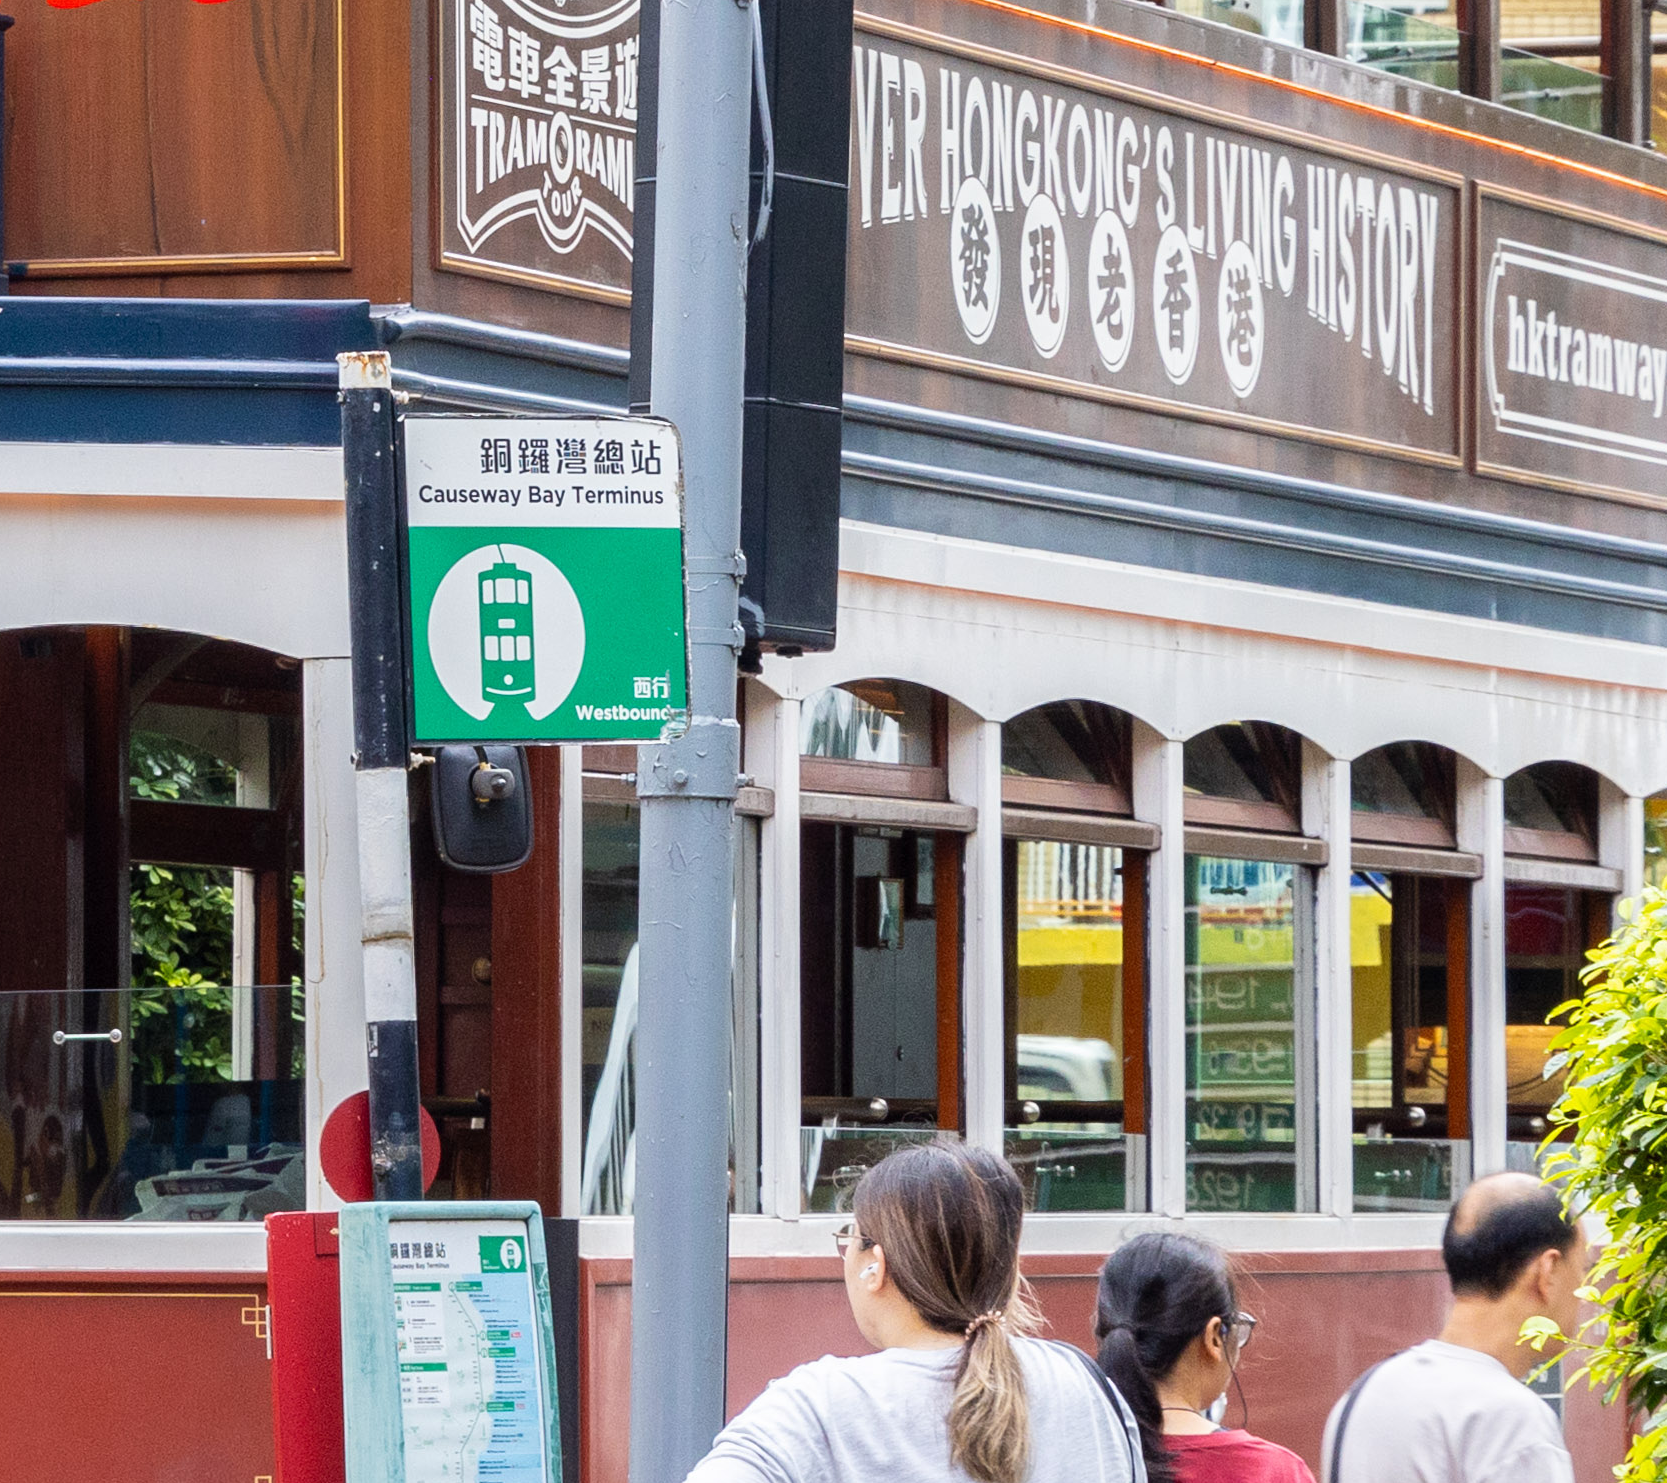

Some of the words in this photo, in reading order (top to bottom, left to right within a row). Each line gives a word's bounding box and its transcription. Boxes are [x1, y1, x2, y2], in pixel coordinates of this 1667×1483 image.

[543, 171, 582, 217] TOUR
[958, 200, 1257, 368] 發現老香港
[1186, 132, 1298, 298] LIVING
[1306, 164, 1439, 416] HISTORY
[480, 438, 662, 475] 銅鑼灣總站
[419, 485, 521, 507] Causeway
[528, 486, 565, 507] Bay
[572, 485, 664, 505] Terminus
[633, 676, 670, 699] 西行
[575, 705, 671, 721] Westbound
